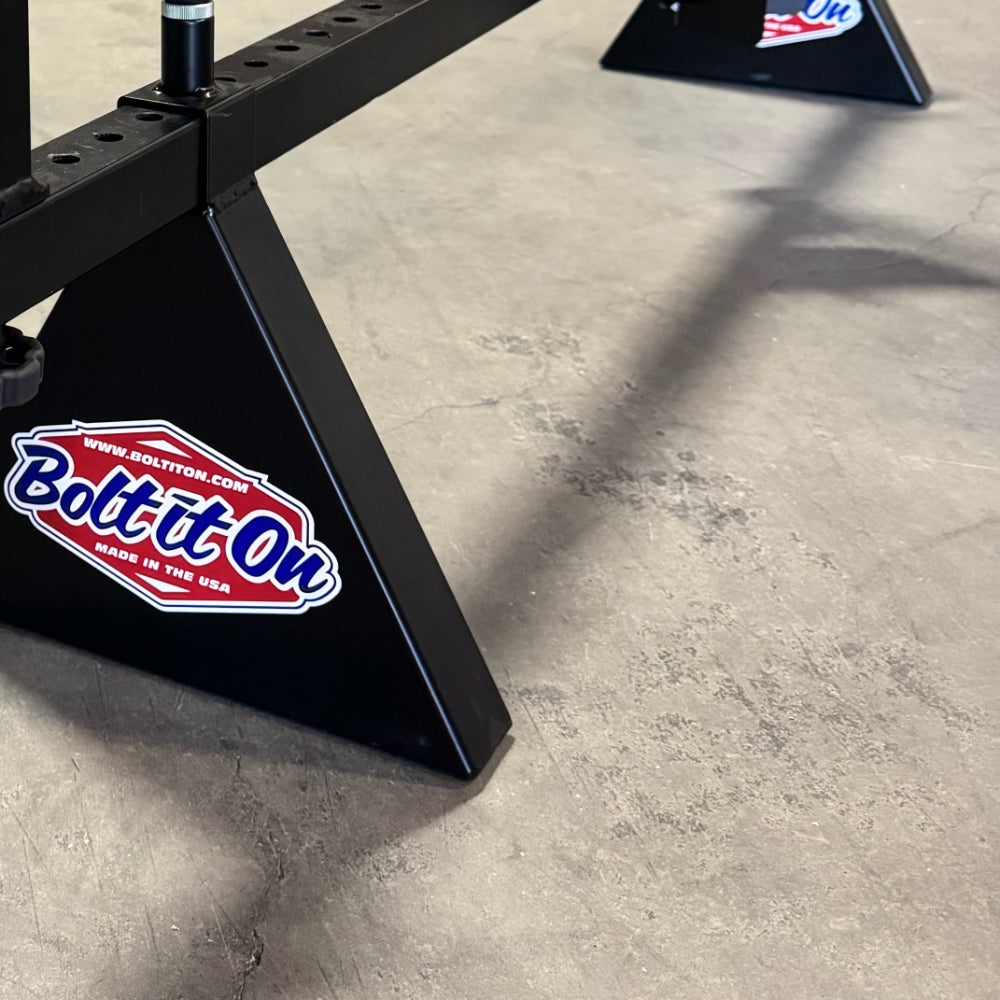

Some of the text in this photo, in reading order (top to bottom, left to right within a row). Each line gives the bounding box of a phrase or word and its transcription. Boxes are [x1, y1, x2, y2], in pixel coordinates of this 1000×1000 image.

[83, 436, 250, 494] WWW.BOLTITON.COM
[14, 444, 330, 593] Bolt it On
[94, 542, 231, 594] MADE IN THE USA
